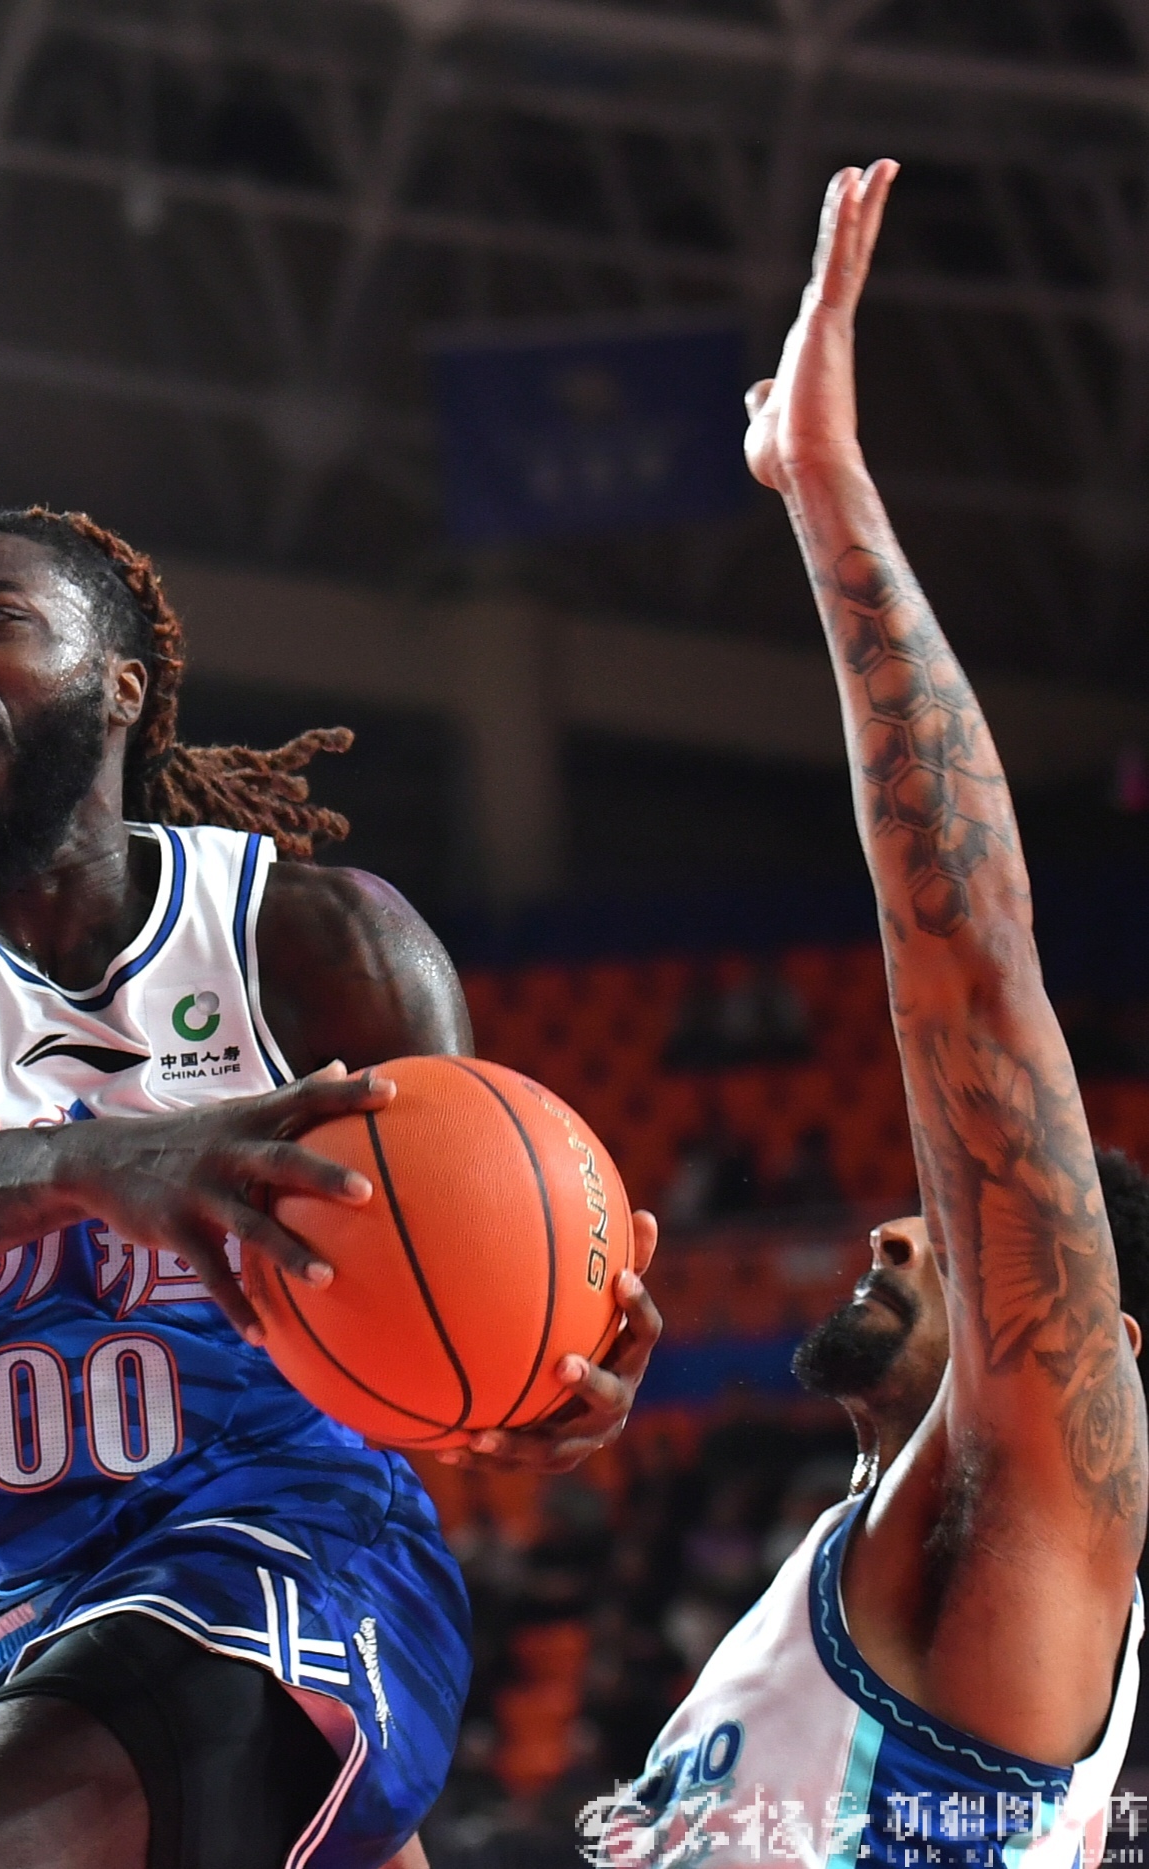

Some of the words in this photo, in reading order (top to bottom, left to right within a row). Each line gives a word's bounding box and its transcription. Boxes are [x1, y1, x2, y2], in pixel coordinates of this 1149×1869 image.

[160, 1045, 240, 1069] 中国人寿
[162, 1069, 207, 1081] CHINA
[211, 1063, 241, 1076] LIFE
